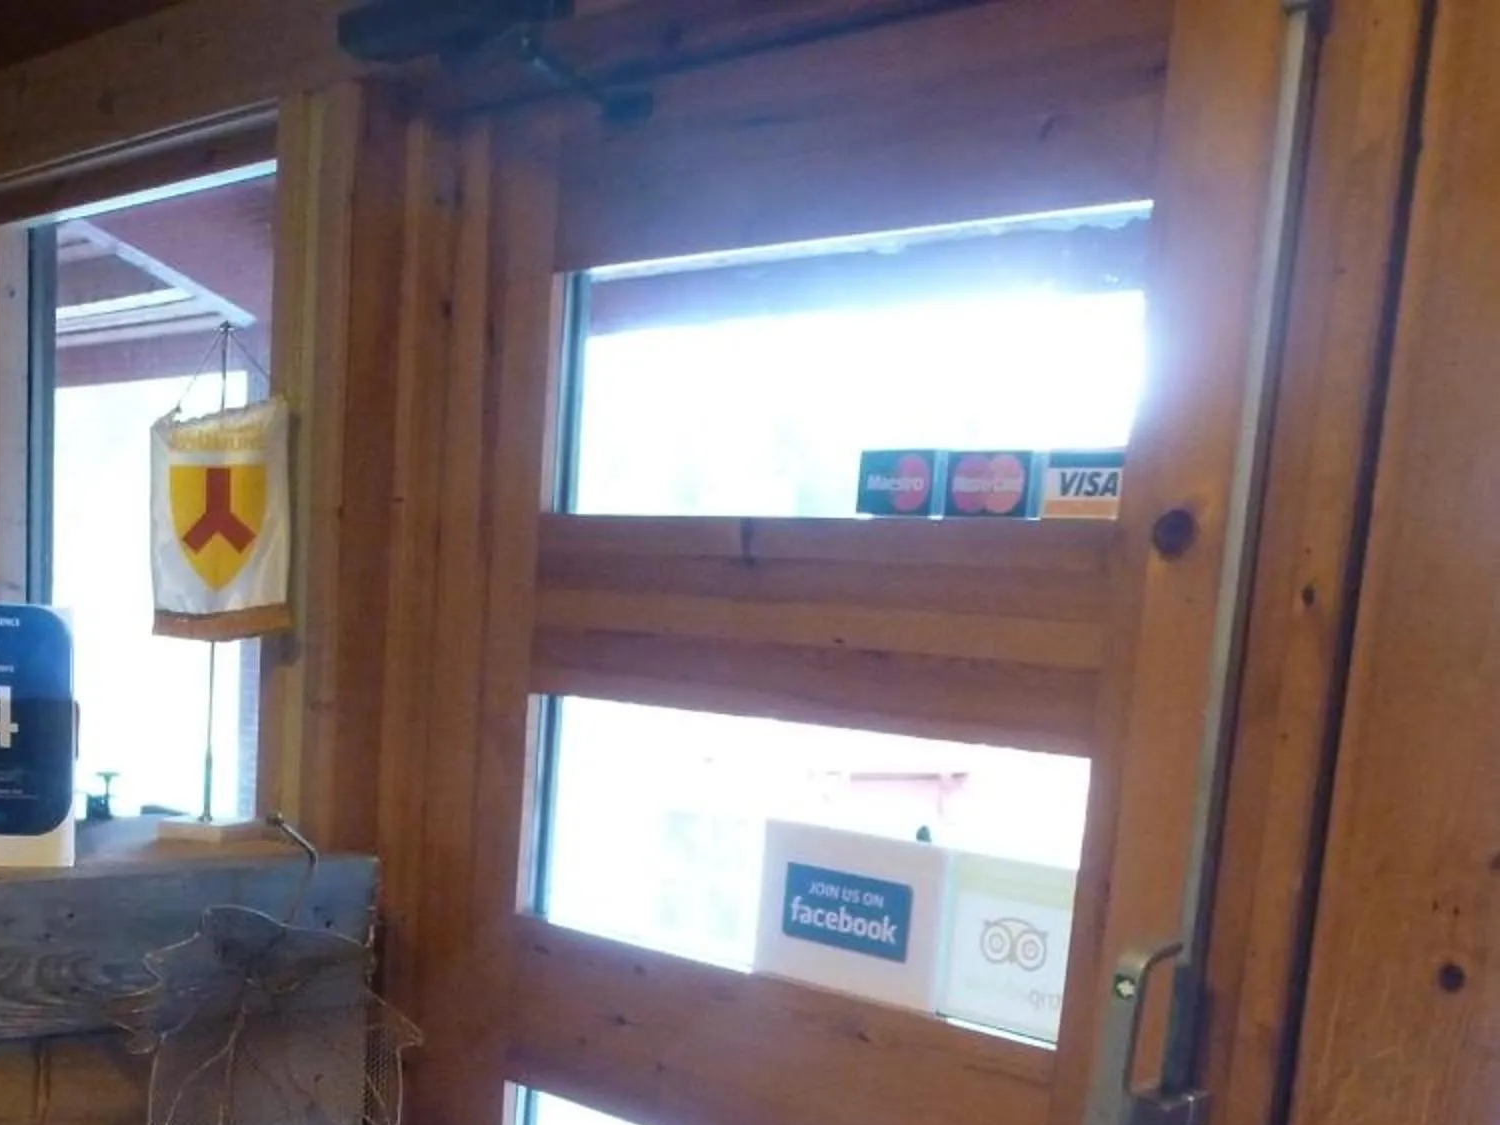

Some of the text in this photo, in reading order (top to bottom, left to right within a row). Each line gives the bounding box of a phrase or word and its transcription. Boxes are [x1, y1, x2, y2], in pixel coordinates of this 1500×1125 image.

[1059, 471, 1119, 497] VISA
[807, 881, 885, 909] JOIN US ON
[790, 895, 899, 945] facebook
